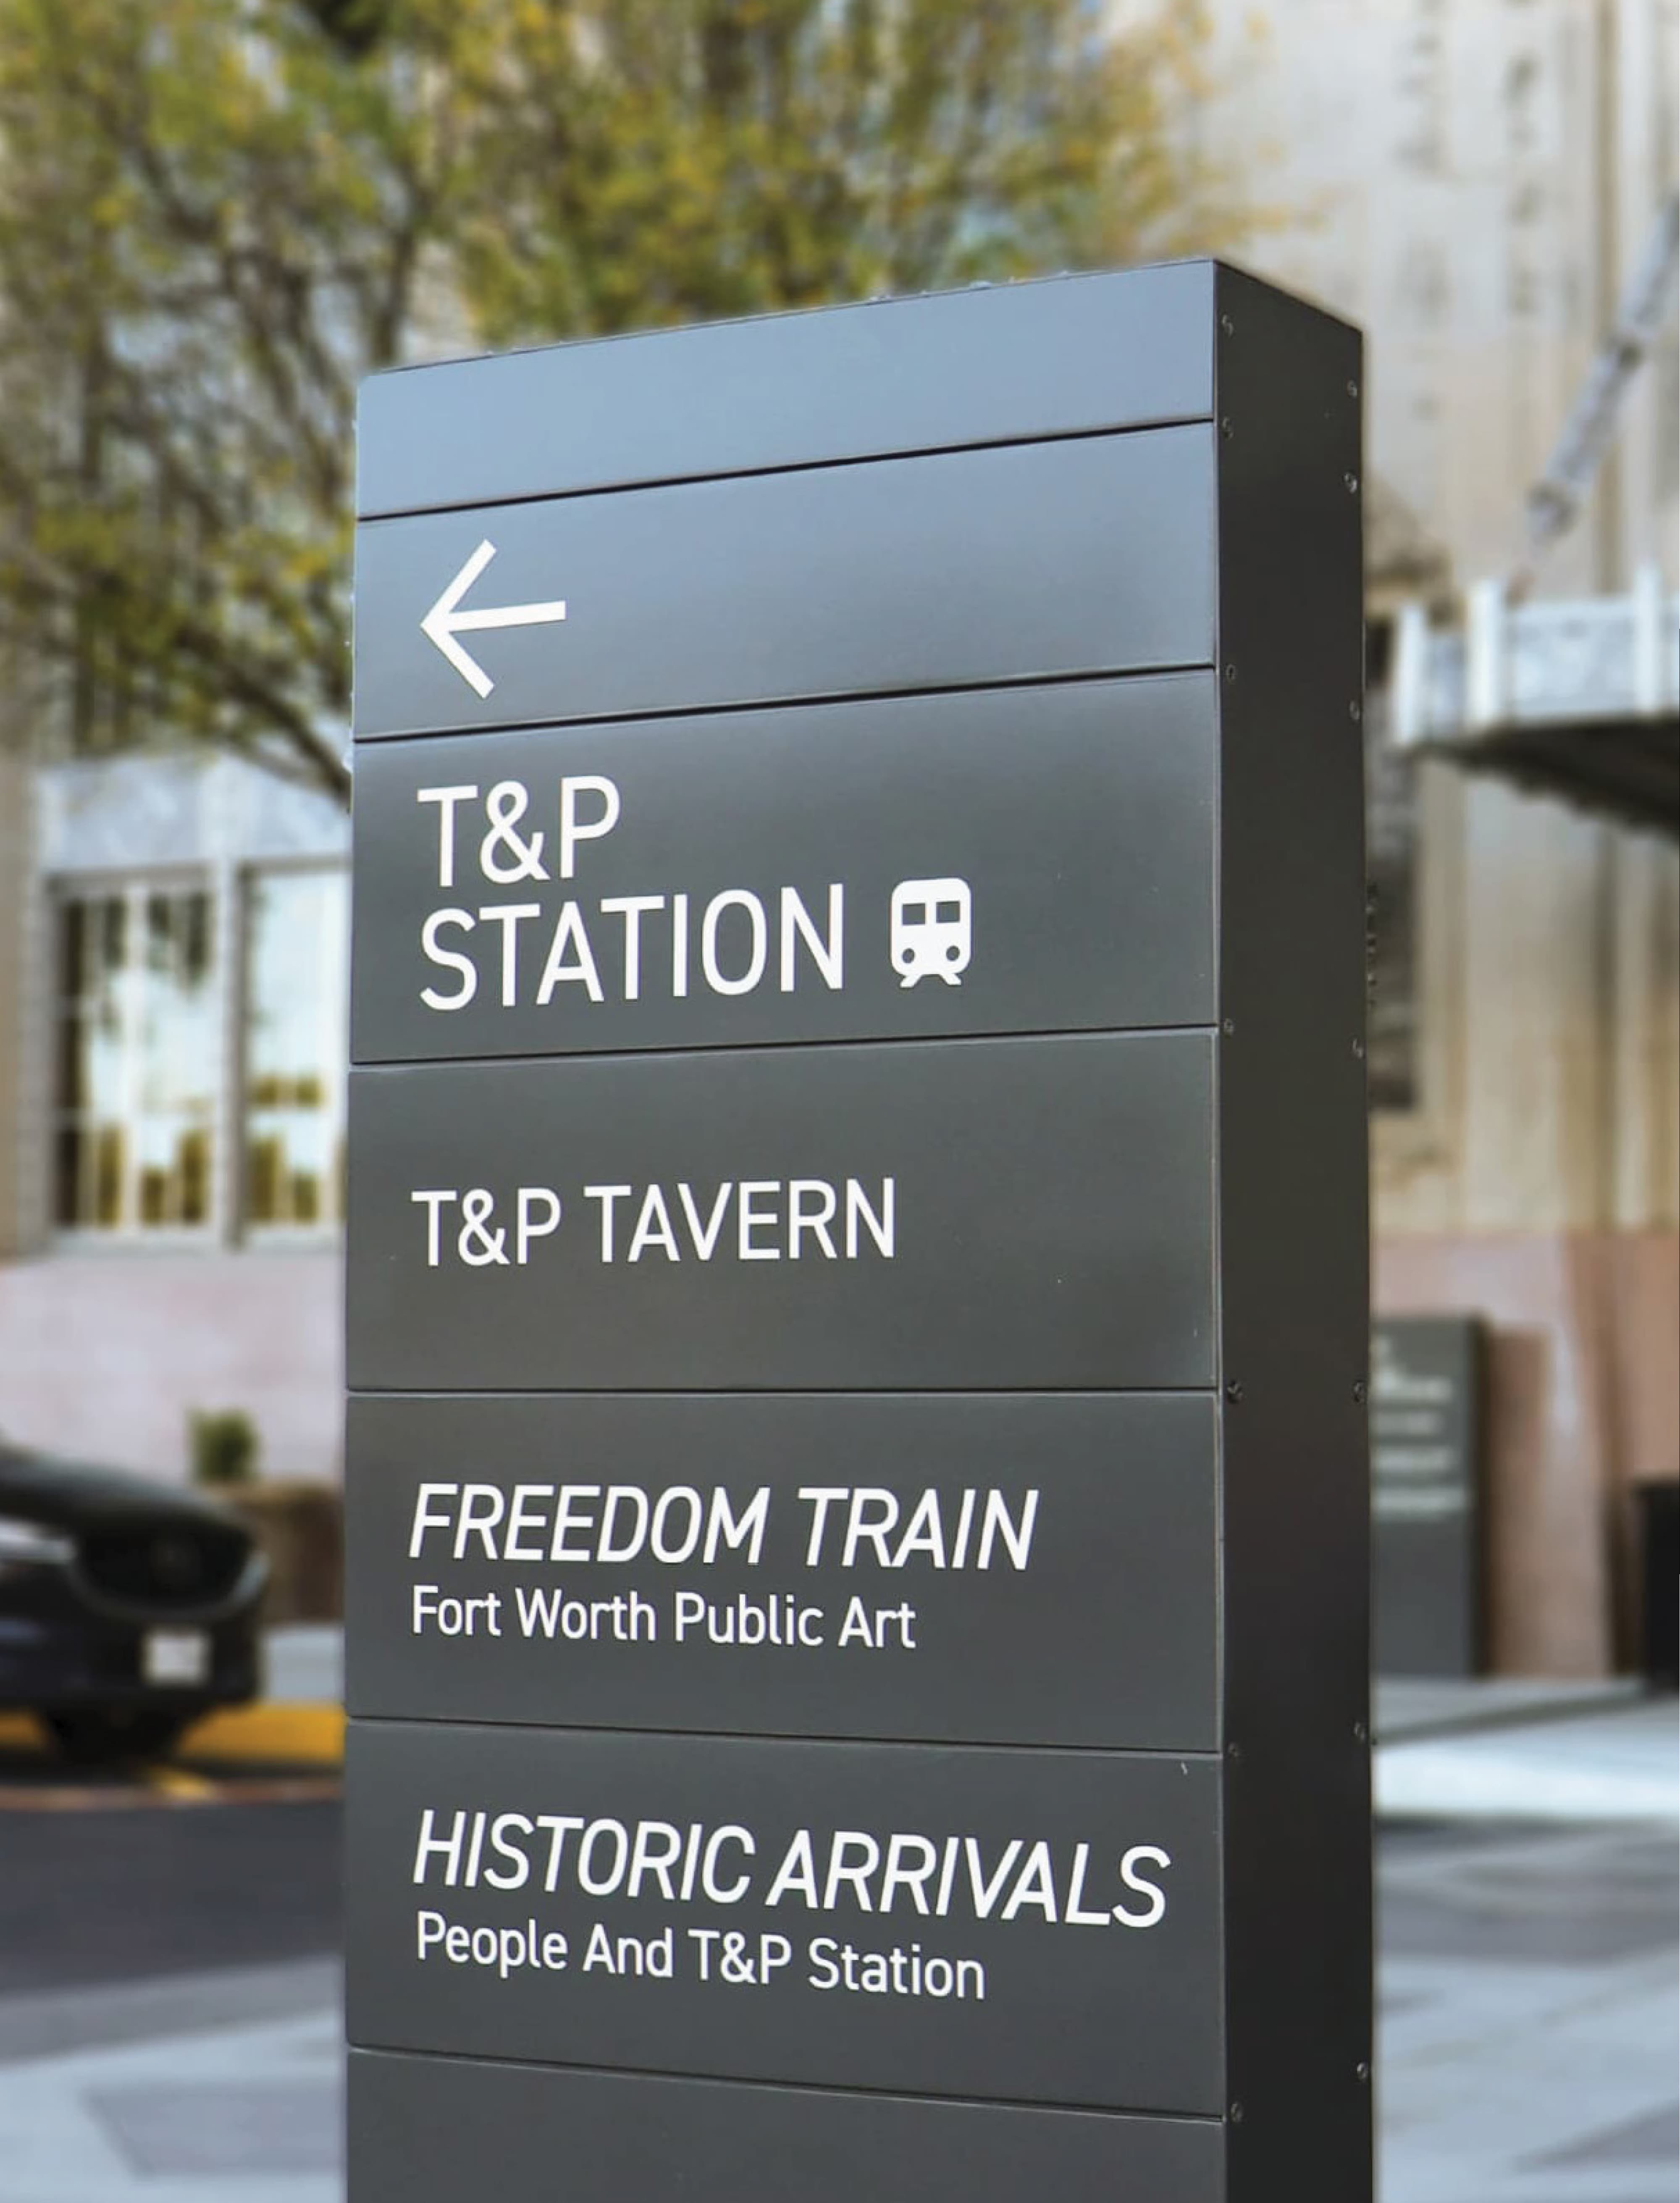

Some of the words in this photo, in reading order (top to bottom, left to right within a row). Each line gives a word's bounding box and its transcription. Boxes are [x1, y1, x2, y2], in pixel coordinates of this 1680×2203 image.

[416, 775, 621, 888] T&P
[419, 882, 845, 1011] STATION
[410, 1187, 562, 1267] T&P
[583, 1176, 895, 1263] TAVERN
[409, 1482, 771, 1564] FREEDOM
[797, 1486, 1040, 1571] TRAIN
[413, 1585, 501, 1637] Fort
[514, 1586, 656, 1641] Worth
[675, 1591, 824, 1647] Public
[837, 1596, 917, 1649] Art
[413, 1809, 756, 1904] HISTORIC
[764, 1829, 1171, 1928] ARRIVALS
[417, 1910, 568, 1979] People
[582, 1923, 673, 1978] And
[687, 1928, 792, 1985] T&P
[808, 1937, 984, 2000] Station
